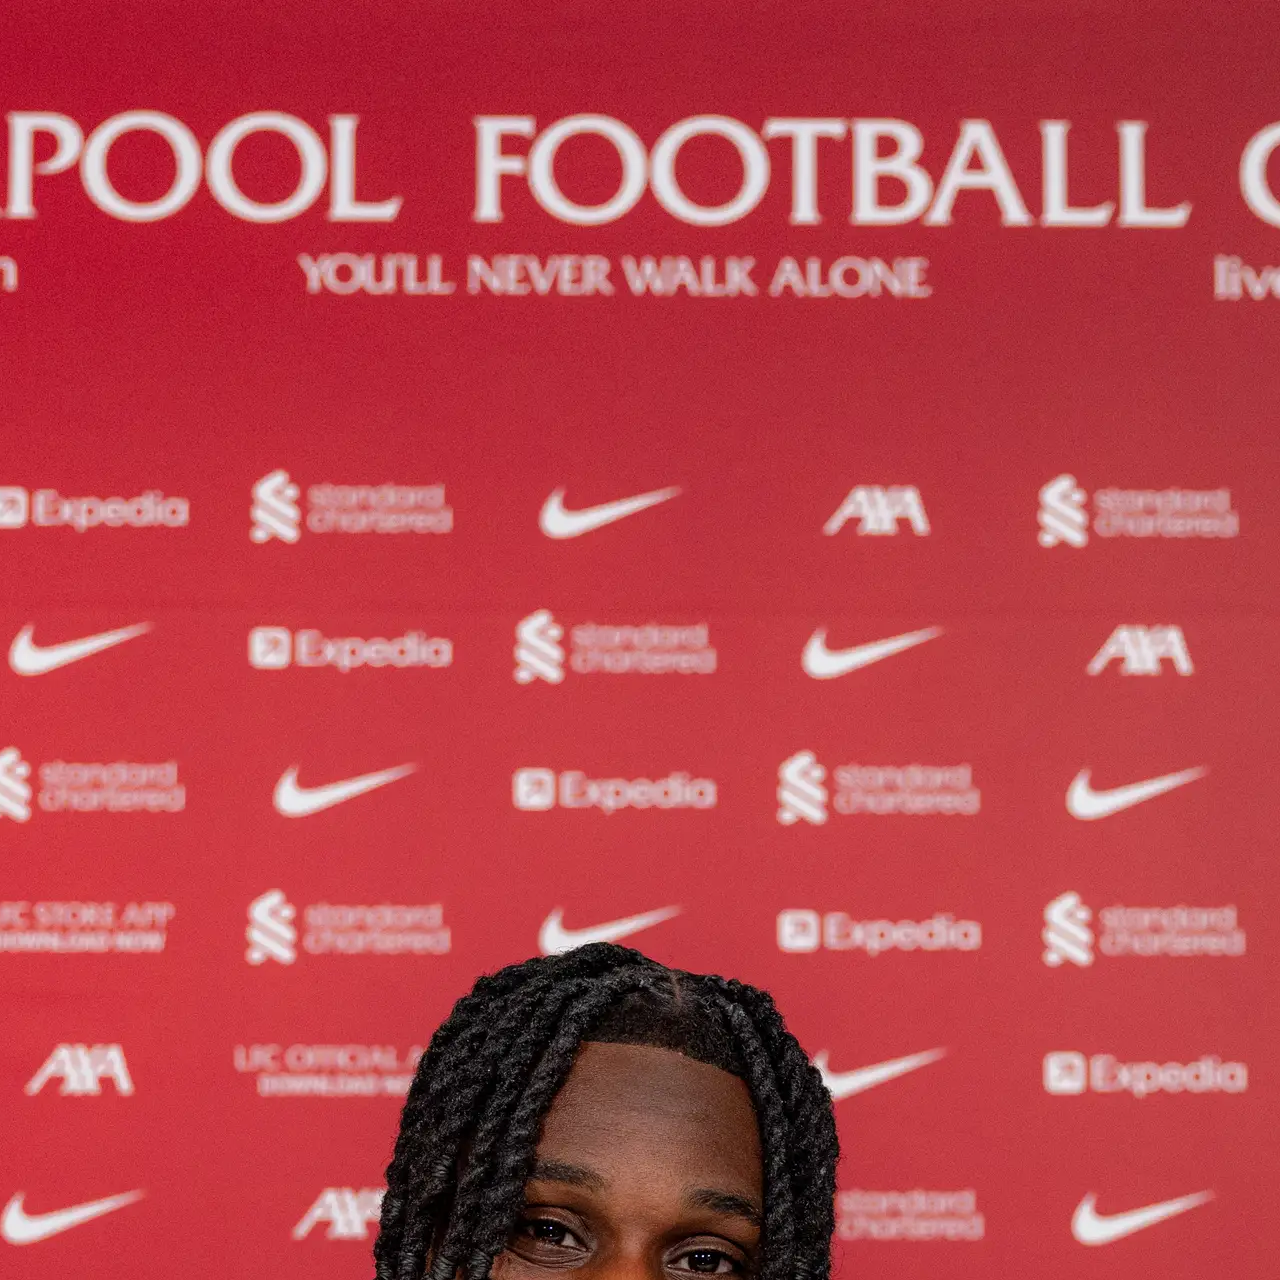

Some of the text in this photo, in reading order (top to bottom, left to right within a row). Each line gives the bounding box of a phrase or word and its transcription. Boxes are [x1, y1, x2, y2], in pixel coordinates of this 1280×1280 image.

[472, 112, 1193, 229] FOOTBALL
[467, 254, 614, 296] NEVER
[623, 256, 756, 297] WALK
[769, 256, 931, 298] ALONE
[30, 489, 190, 531] Expedia
[826, 486, 929, 535] AXA
[293, 630, 453, 671] Expedia
[1089, 626, 1192, 675] AXA
[557, 771, 717, 812] Expedia
[822, 912, 982, 954] Expedia
[28, 1044, 132, 1095] AXA
[1088, 1054, 1248, 1096] Expedia
